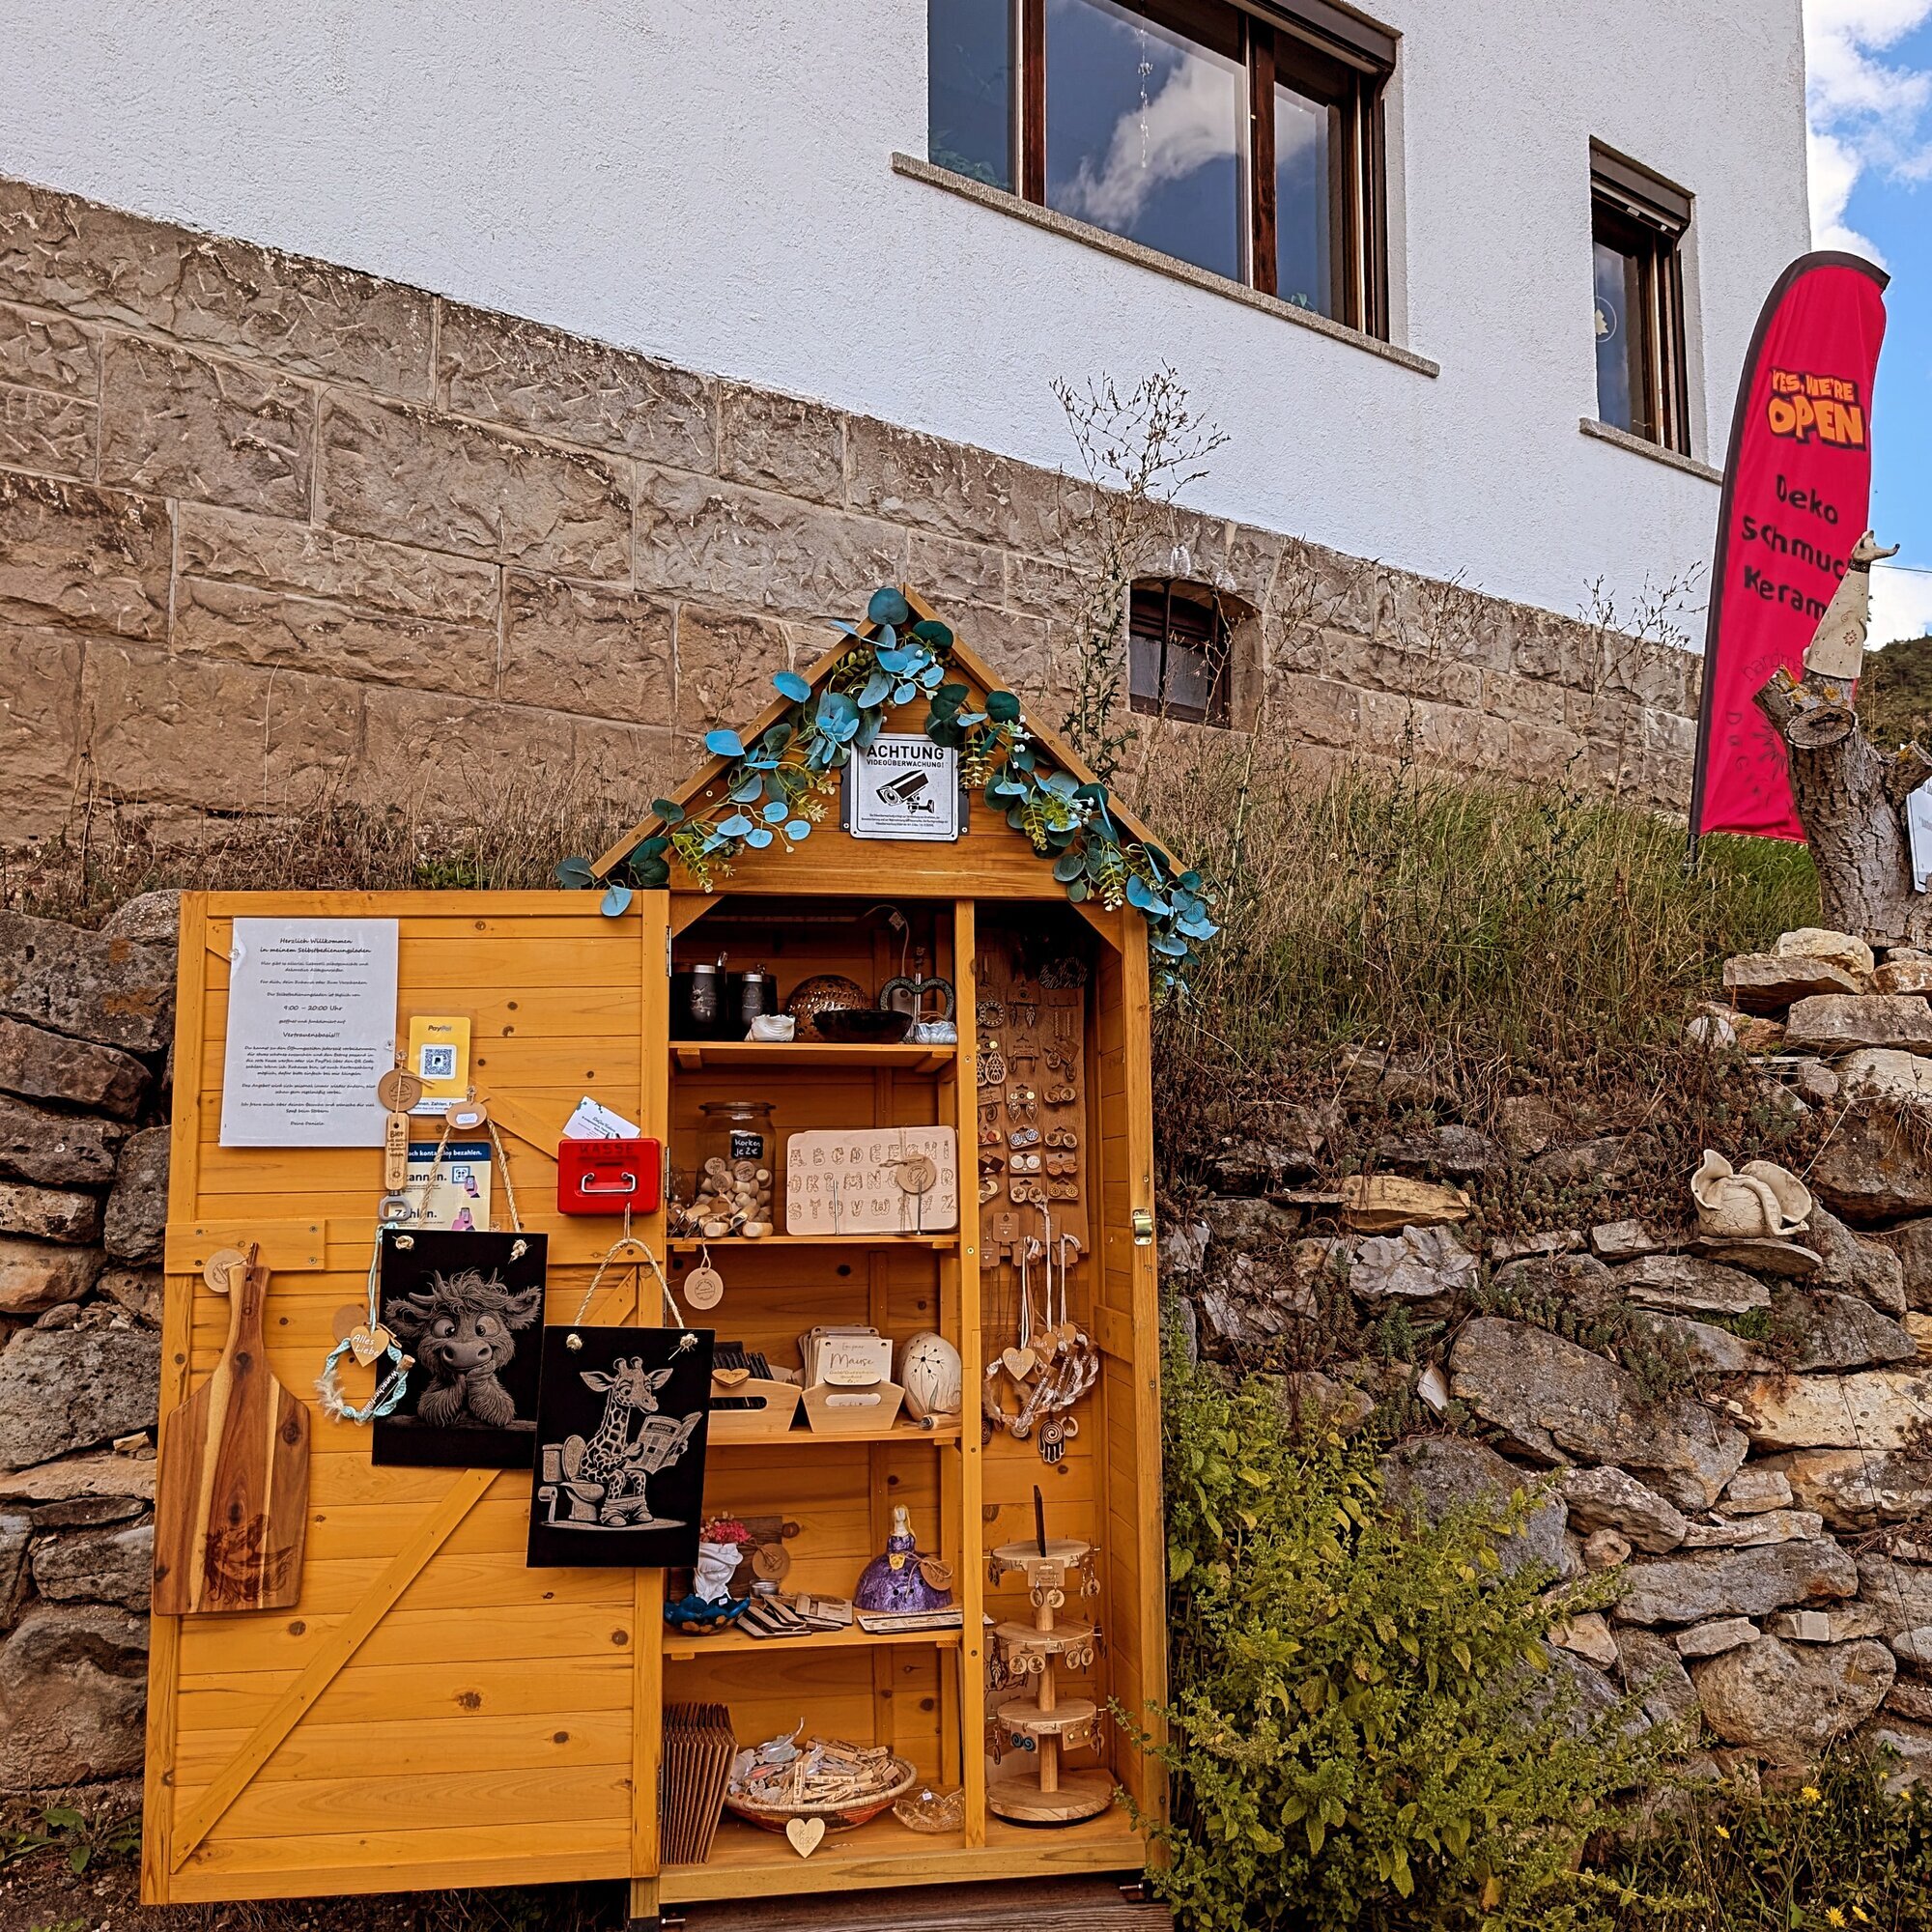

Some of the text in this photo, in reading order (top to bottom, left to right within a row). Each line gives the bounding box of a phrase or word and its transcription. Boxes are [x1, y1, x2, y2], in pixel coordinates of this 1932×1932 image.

[1772, 369, 1856, 402] YES, WE'RE
[1768, 394, 1864, 445] OPEN
[1776, 473, 1839, 525] Deko
[1741, 515, 1852, 581] Schmuc
[866, 744, 944, 760] ACHTUNG
[866, 758, 945, 769] VIDEOÜBERWACHUNG!
[579, 1143, 635, 1154] KASSE
[352, 1333, 375, 1346] Alles
[355, 1344, 380, 1356] Liebe
